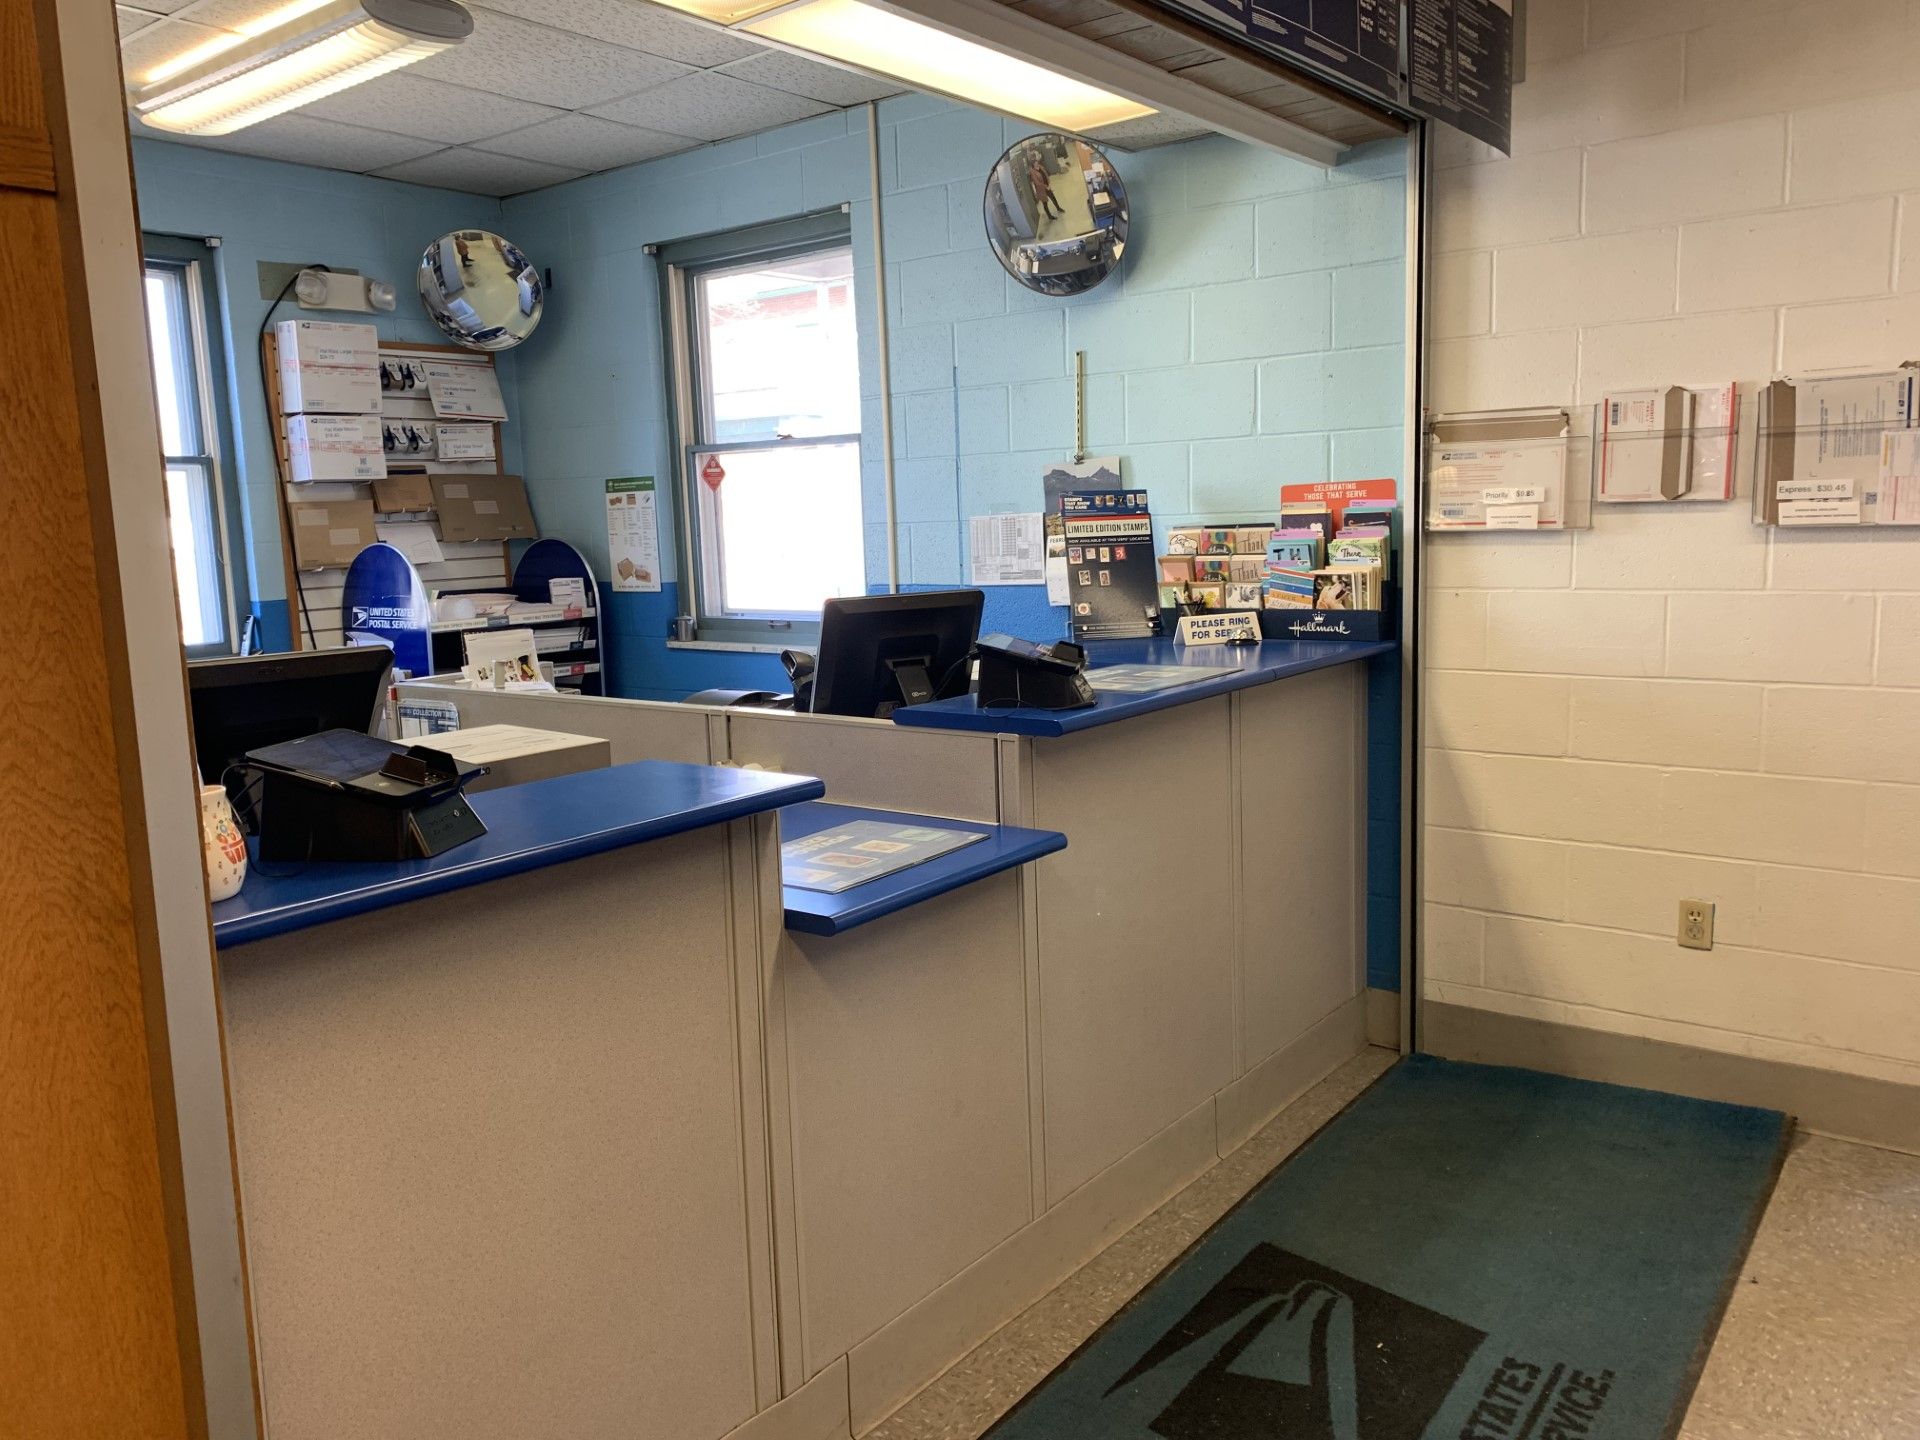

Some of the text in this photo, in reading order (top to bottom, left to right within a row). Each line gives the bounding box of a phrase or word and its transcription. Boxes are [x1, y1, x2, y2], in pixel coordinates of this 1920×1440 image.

[1313, 482, 1357, 492] CELEBRATING
[1778, 486, 1812, 495] Express
[1303, 489, 1368, 500] THOSE THAT SERVE
[1067, 522, 1149, 534] LIMITED EDITION STAMPS
[369, 607, 417, 617] UNITED STATES
[368, 619, 418, 629] POSTAL SERVICE
[1190, 617, 1251, 629] PLEASE RING
[1288, 619, 1351, 638] Hallmark
[1191, 630, 1210, 639] FOR
[412, 709, 442, 717] COLLECTION
